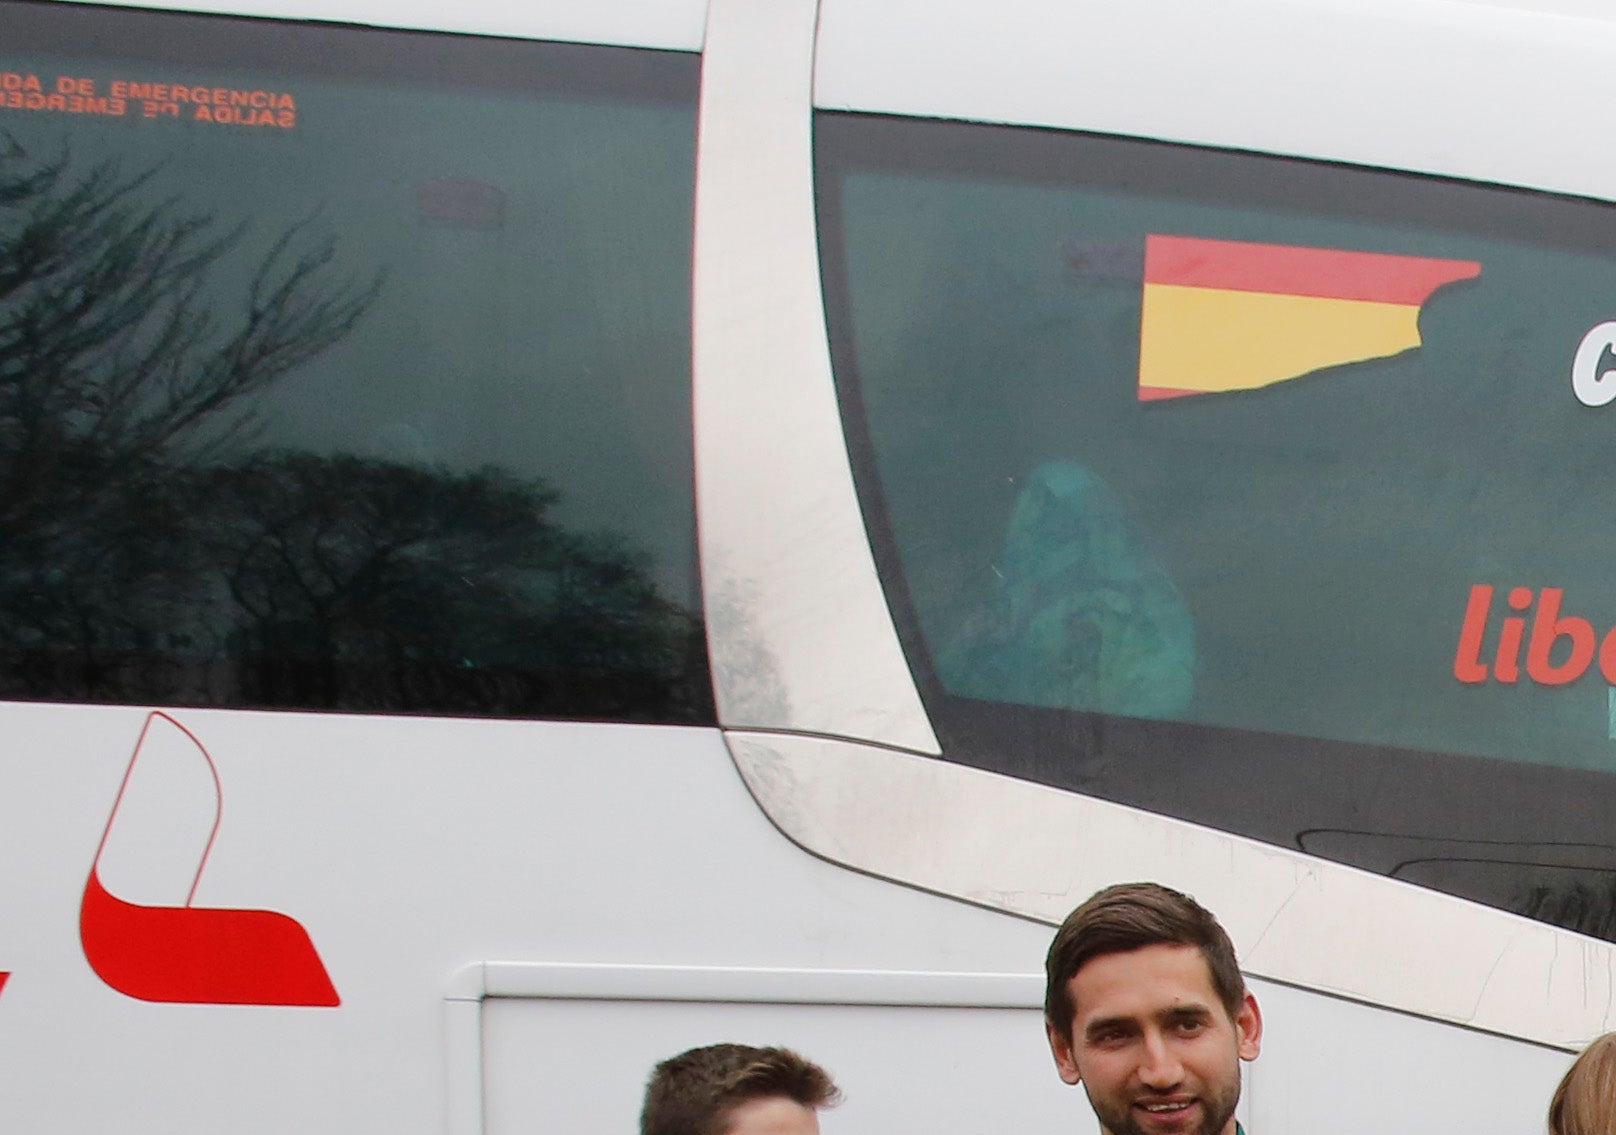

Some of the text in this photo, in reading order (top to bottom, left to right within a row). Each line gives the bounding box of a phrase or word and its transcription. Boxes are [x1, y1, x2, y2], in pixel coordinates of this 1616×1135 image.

[0, 73, 295, 112] DA DE EMERGENCIA
